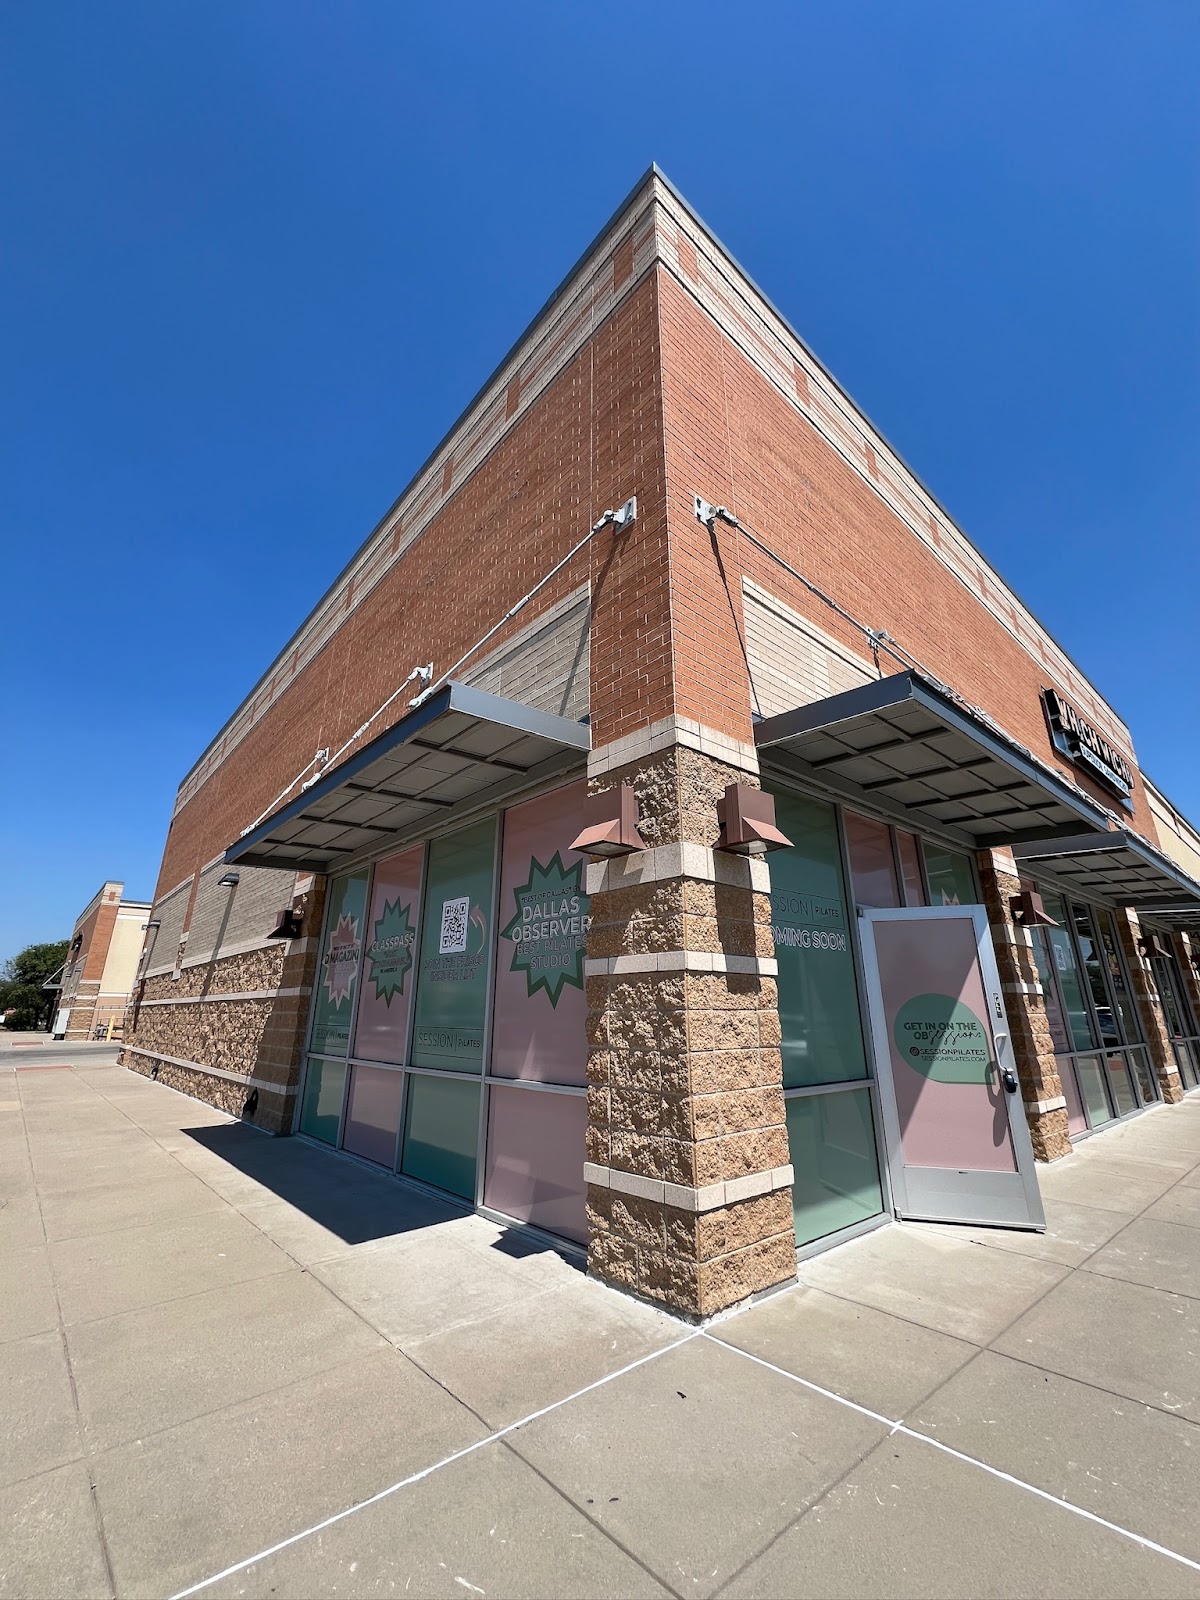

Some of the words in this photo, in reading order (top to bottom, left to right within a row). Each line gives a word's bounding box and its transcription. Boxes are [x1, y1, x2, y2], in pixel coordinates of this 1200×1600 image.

[522, 896, 580, 923] DALLAS
[814, 905, 839, 917] PILATES
[512, 915, 590, 943] OBSERVER
[371, 932, 415, 952] CLASSPASS
[517, 941, 541, 955] BEST
[544, 934, 588, 952] PILATES
[812, 930, 847, 952] SOON
[441, 956, 456, 969] THE
[457, 954, 485, 968] FRISCO
[530, 953, 571, 969] STUDIO
[460, 968, 478, 981] LIST
[904, 1022, 923, 1031] GET
[925, 1022, 936, 1031] IN
[938, 1022, 954, 1031] ON
[956, 1022, 978, 1031] THE
[419, 1032, 454, 1049] SESSION
[458, 1038, 481, 1048] PILATES
